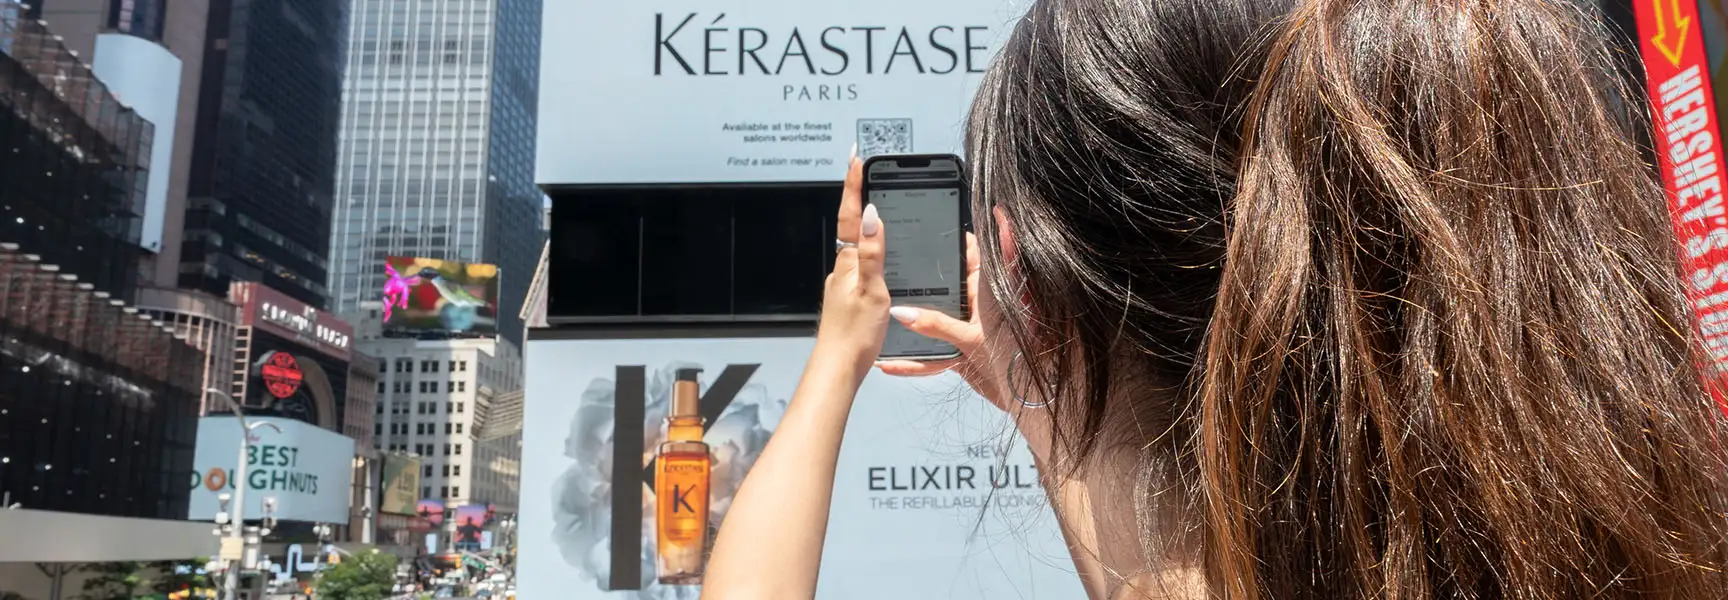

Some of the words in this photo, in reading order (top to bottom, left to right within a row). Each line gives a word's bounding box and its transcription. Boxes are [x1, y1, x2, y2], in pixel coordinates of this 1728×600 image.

[653, 12, 988, 76] KÉRASTASE
[783, 84, 858, 101] PARIS
[722, 122, 768, 131] Available
[772, 123, 781, 131] at
[785, 122, 800, 131] the
[804, 121, 832, 130] finest
[743, 134, 776, 143] salons
[780, 133, 832, 142] worldwide
[727, 157, 750, 166] Find
[761, 158, 787, 166] salon
[815, 159, 834, 168] you
[1658, 64, 1728, 257] HERSHEY'S
[248, 445, 298, 467] BEST
[967, 445, 1009, 459] NEW
[868, 466, 975, 491] ELIXIR
[673, 484, 696, 513] K
[870, 496, 899, 509] THE
[903, 494, 990, 508] REFILLABLE
